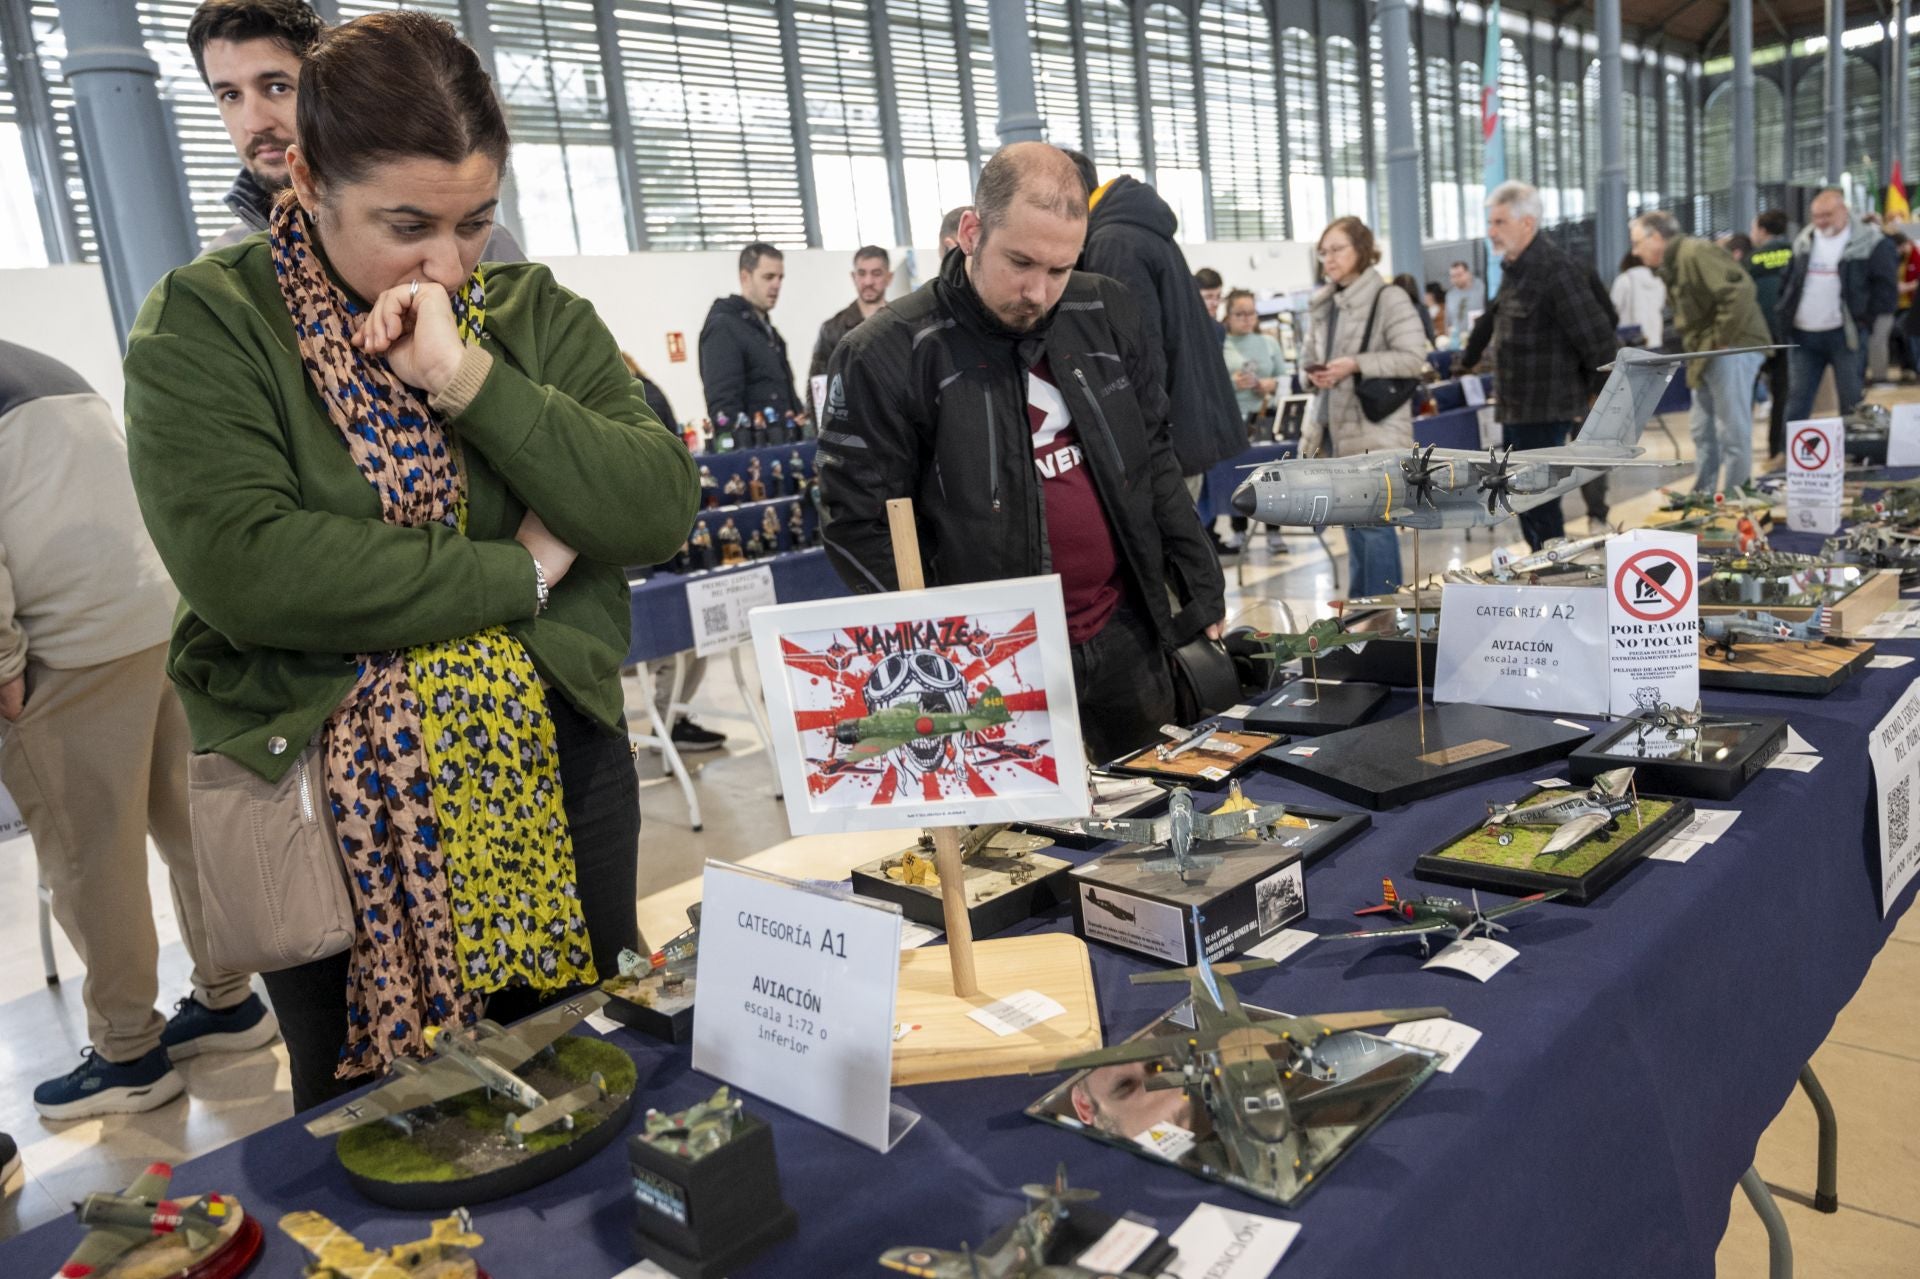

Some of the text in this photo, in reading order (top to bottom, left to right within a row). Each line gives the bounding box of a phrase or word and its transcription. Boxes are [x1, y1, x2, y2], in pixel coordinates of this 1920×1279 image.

[1552, 605, 1575, 620] A2
[1611, 621, 1696, 635] POR FAVOR
[855, 619, 972, 659] KAMIKAZE
[1491, 640, 1553, 653] AVIACIÓN
[1615, 635, 1692, 648] NO TOCAR
[1484, 655, 1518, 664] escala
[1524, 656, 1547, 666] 1:48
[1881, 715, 1904, 748] PREMIO
[1894, 741, 1907, 763] DEL
[738, 911, 848, 959] CATEGORÍA A1
[752, 975, 822, 1014] AVIACIÓN
[744, 1000, 828, 1040] escala 1:72 o
[758, 1024, 810, 1055] inferior
[1202, 1219, 1263, 1279] ENCIÓN
